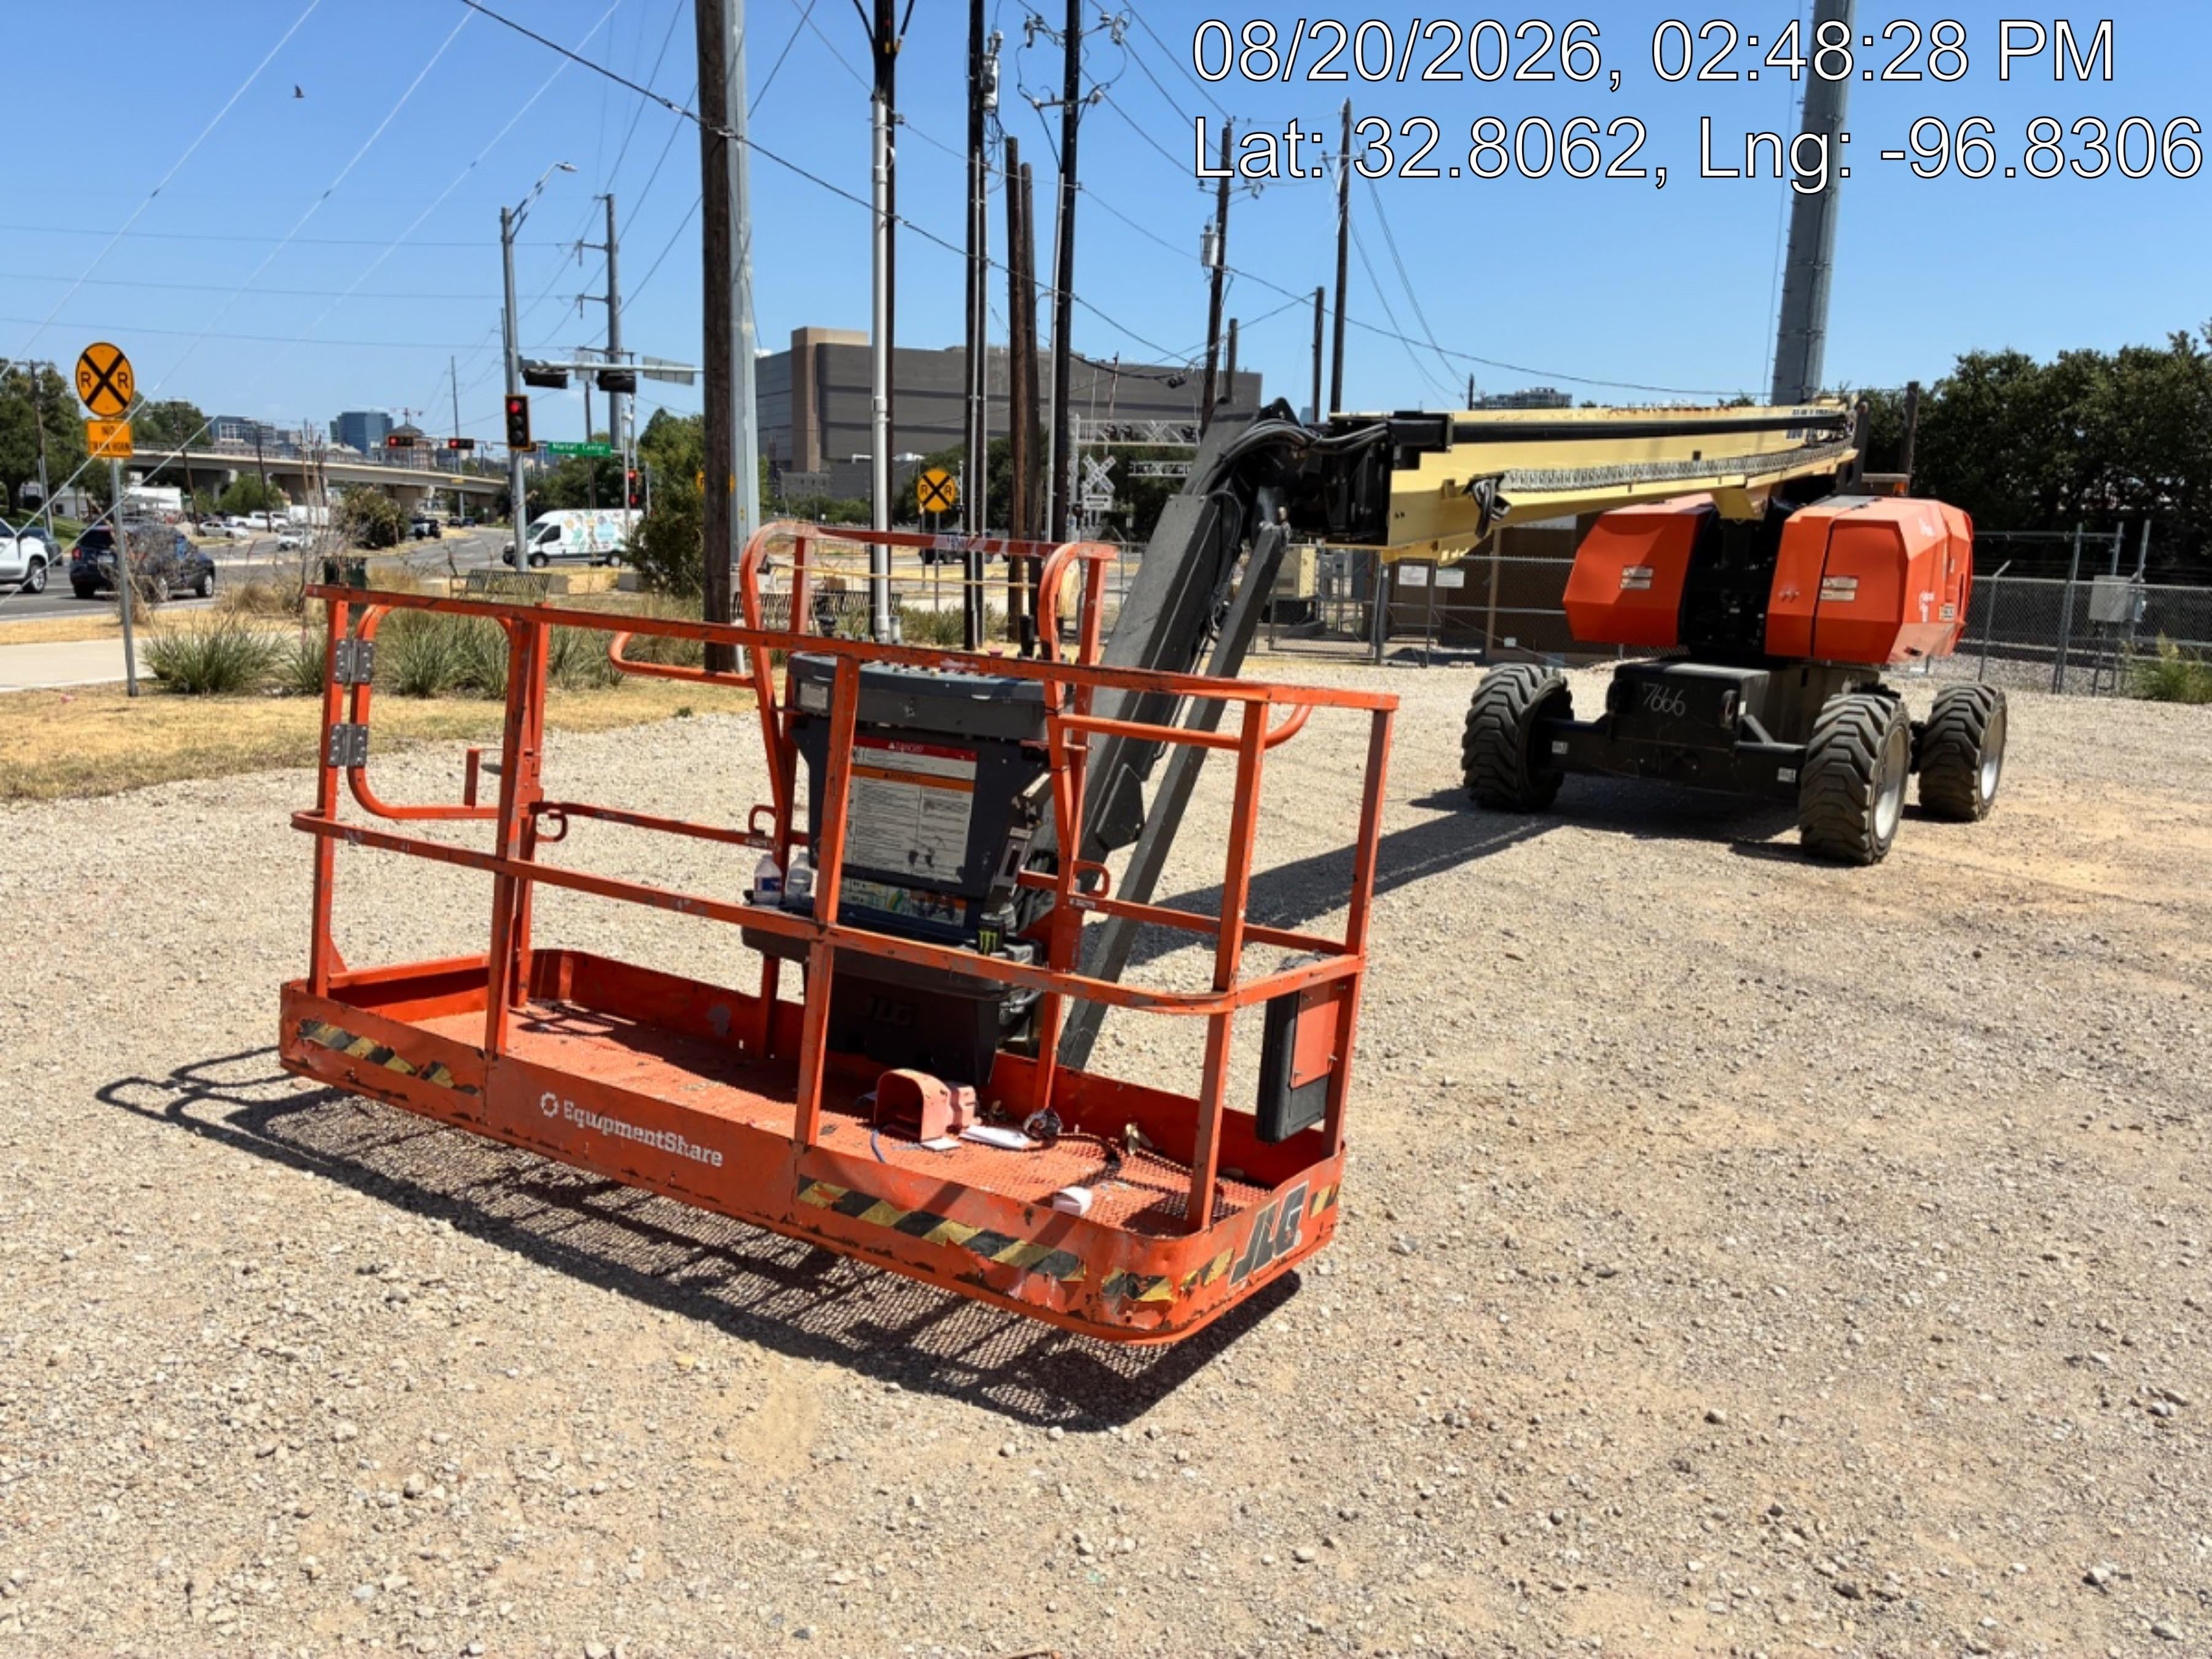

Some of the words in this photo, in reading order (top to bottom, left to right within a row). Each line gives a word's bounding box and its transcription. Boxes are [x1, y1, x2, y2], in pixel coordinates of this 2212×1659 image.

[81, 372, 91, 388] R
[118, 372, 128, 388] R
[1642, 683, 1685, 718] 7666
[563, 1100, 723, 1167] EquipmentShare
[1228, 1180, 1309, 1288] JLG
